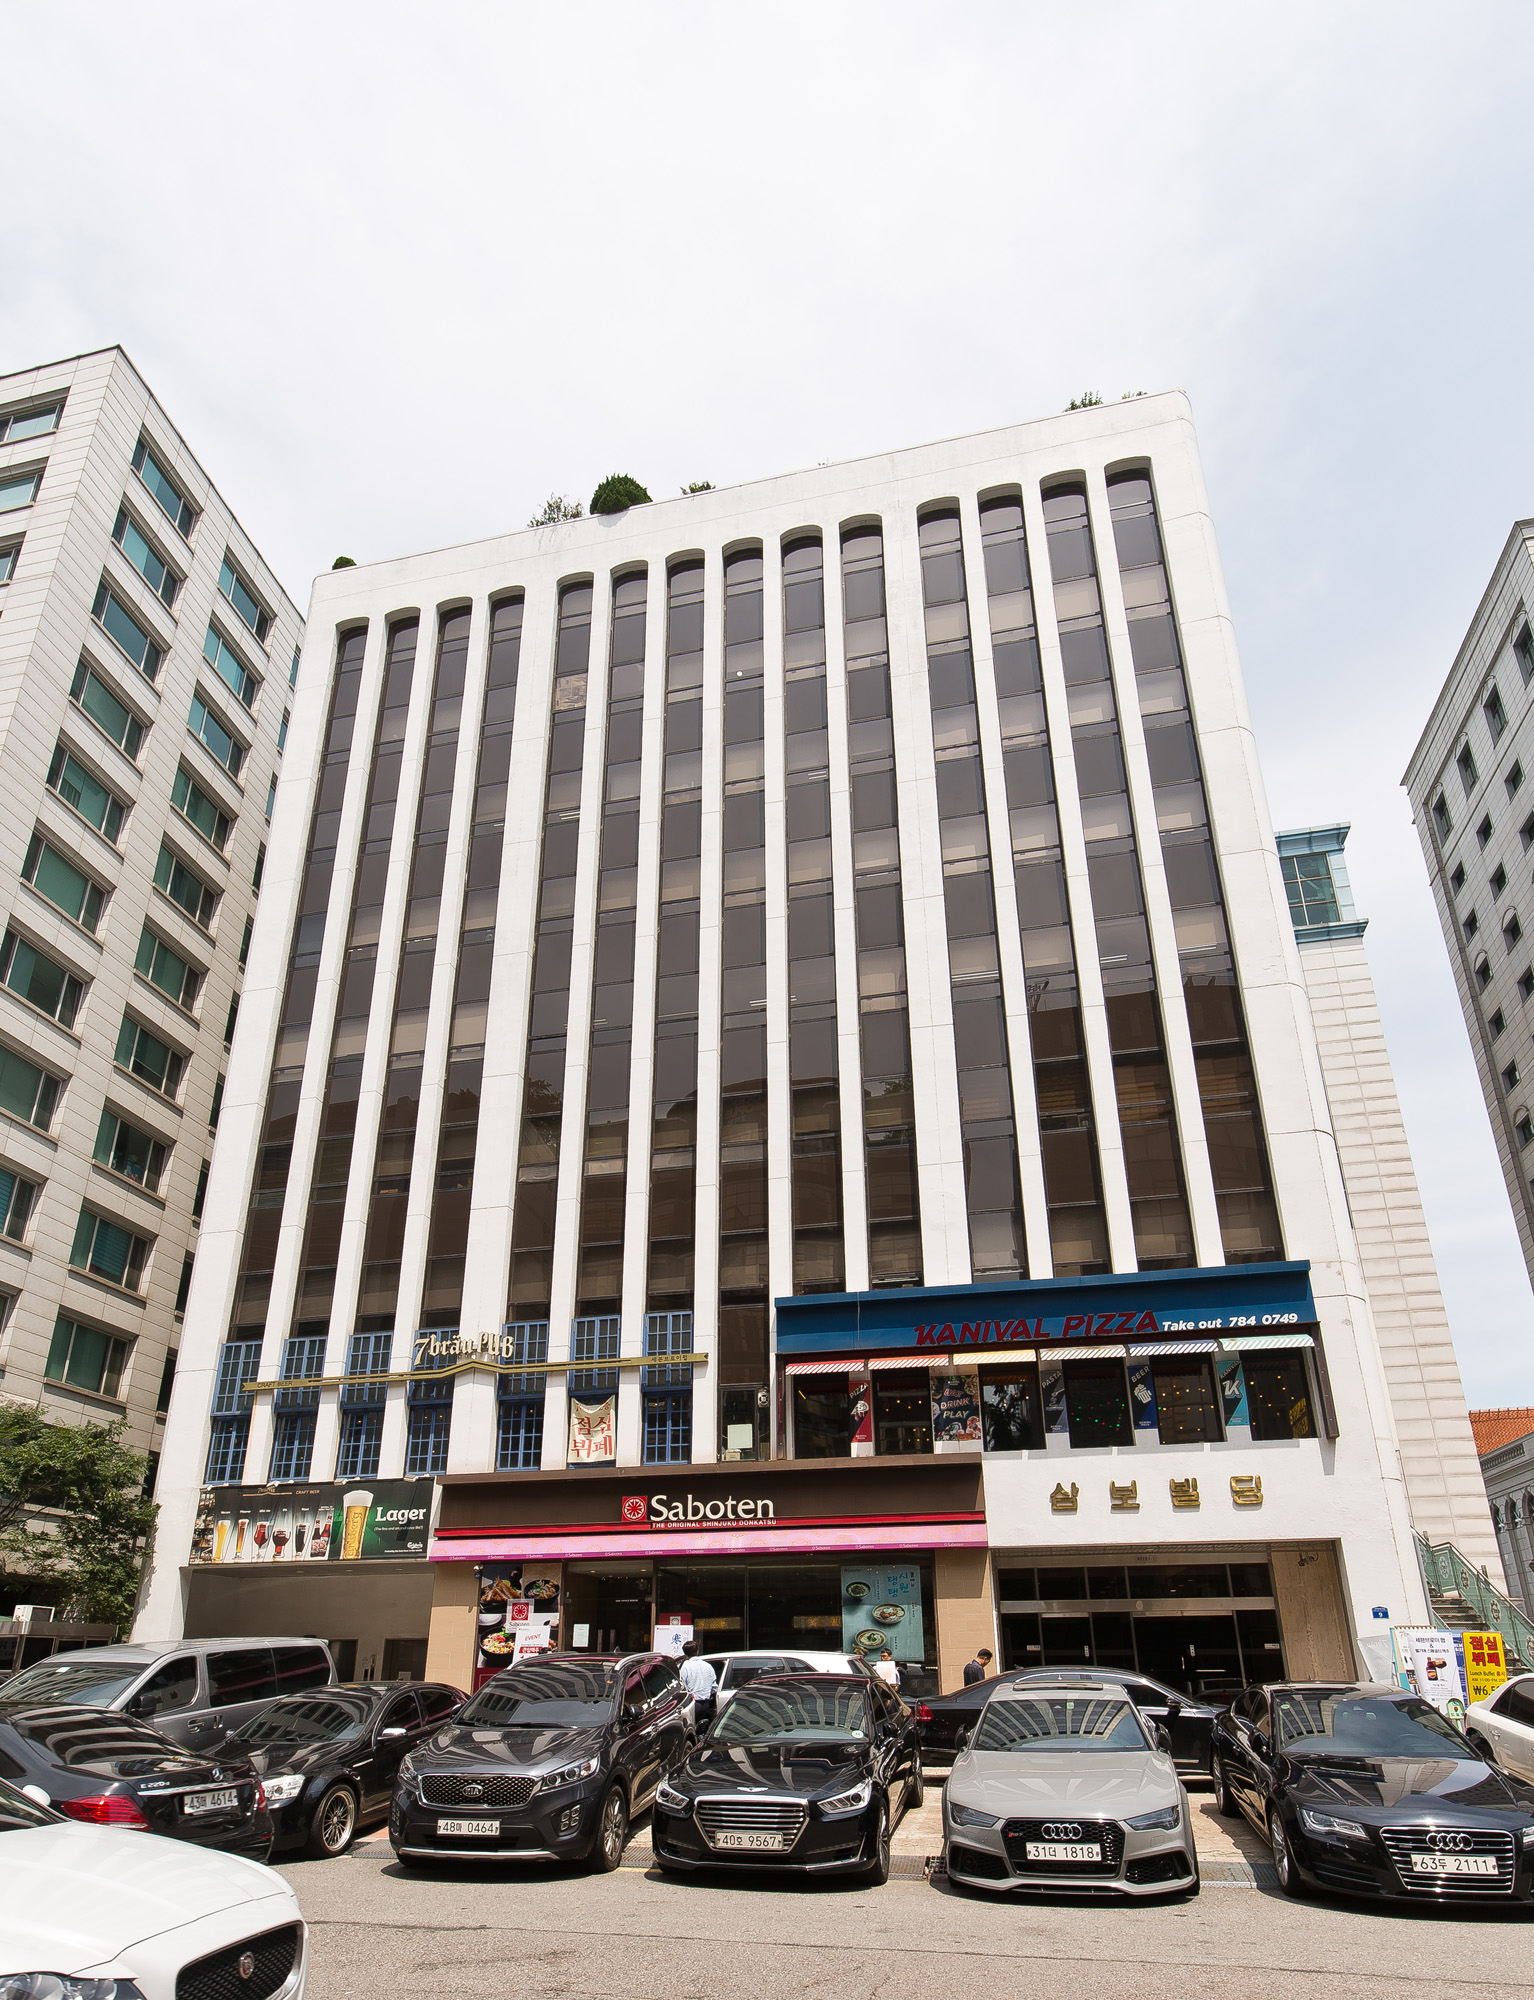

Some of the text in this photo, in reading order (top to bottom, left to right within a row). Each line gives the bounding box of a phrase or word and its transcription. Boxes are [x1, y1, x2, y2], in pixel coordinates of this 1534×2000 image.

[914, 1310, 1160, 1346] KANIVAL PIZZA
[1162, 1313, 1298, 1332] Take out 784 0749
[1041, 1370, 1063, 1389] PASTA
[1131, 1365, 1150, 1383] BEER
[849, 1382, 869, 1399] PIZZA
[940, 1397, 970, 1410] DRINK
[943, 1410, 970, 1419] PLAY
[572, 1413, 612, 1436] 점심
[571, 1435, 613, 1458] 뷔페
[1050, 1474, 1264, 1510] 삼보빌딩
[375, 1506, 426, 1524] Lager
[650, 1494, 775, 1522] Saboten
[899, 1572, 910, 1594] 시원
[524, 1633, 541, 1641] EVENT
[1469, 1636, 1498, 1651] 점심
[1472, 1652, 1501, 1667] 뷔페
[210, 1791, 233, 1806] 4614
[468, 1822, 494, 1833] 0464
[722, 1835, 776, 1848] 40호 9567
[1032, 1846, 1094, 1859] 31더 1818
[1420, 1857, 1489, 1872] 63두 2111
